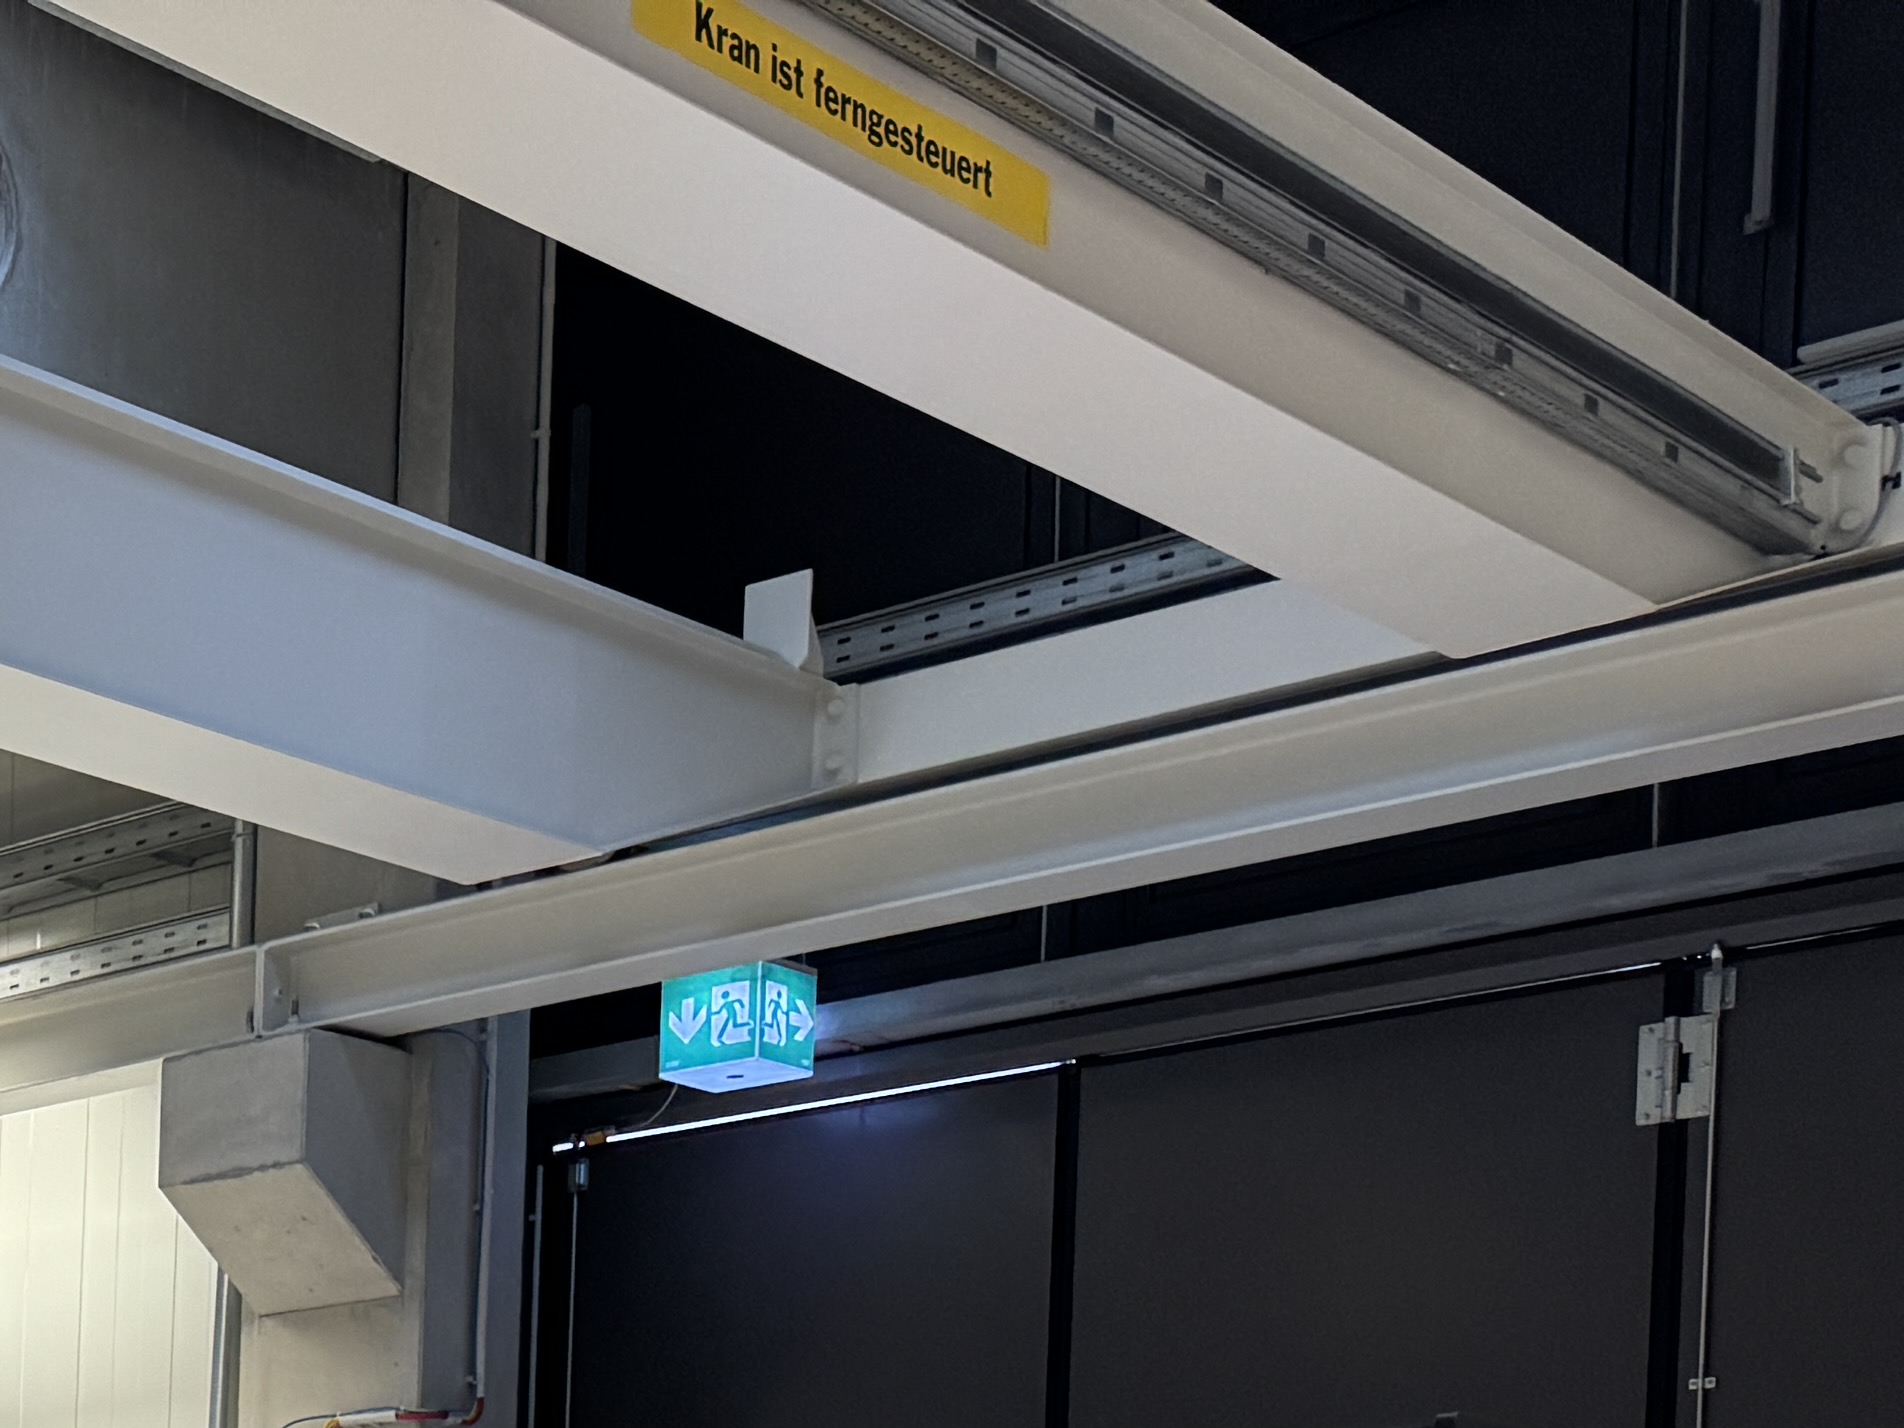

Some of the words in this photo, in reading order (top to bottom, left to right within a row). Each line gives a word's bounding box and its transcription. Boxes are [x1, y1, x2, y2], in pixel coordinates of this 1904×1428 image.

[695, 3, 761, 74] Kran
[770, 43, 804, 99] ist
[814, 68, 993, 199] ferngesteuert
